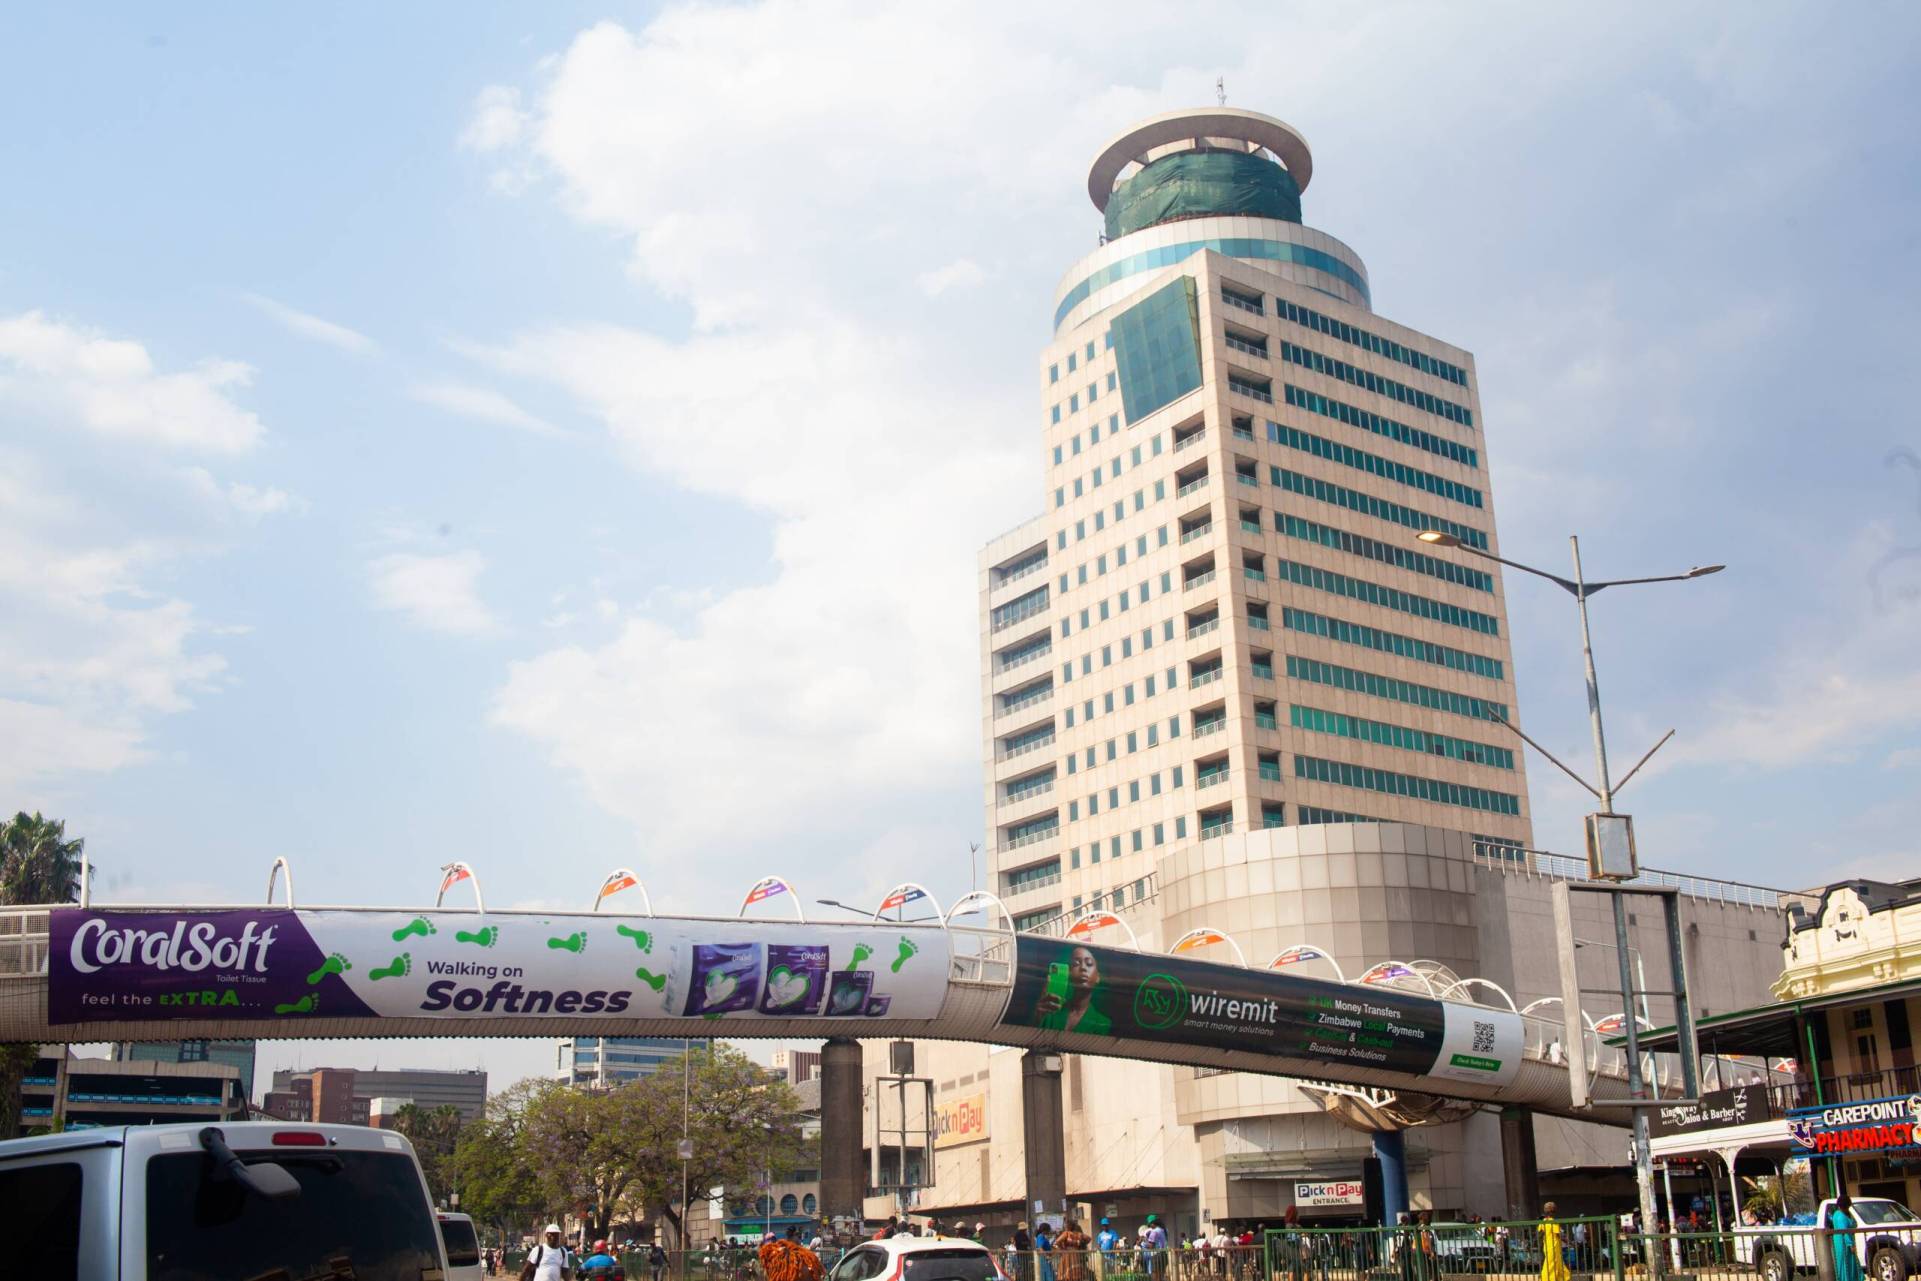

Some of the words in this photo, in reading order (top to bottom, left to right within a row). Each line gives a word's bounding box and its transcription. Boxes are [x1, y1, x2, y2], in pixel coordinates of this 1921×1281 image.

[70, 918, 277, 973] CoralSoft
[216, 974, 239, 983] Toilet
[242, 974, 267, 984] Tissue
[427, 961, 498, 979] Walking
[502, 965, 523, 978] on
[81, 993, 115, 1006] feel
[122, 993, 153, 1006] the
[420, 980, 632, 1014] Softness
[1191, 990, 1279, 1024] wiremit
[1334, 1000, 1362, 1015] Money
[1363, 1003, 1401, 1019] Transfers
[1184, 1019, 1209, 1030] smart
[1209, 1022, 1238, 1034] money
[1239, 1024, 1275, 1037] solutions
[1318, 1012, 1362, 1029] Zimbabwe
[1386, 1022, 1425, 1039] Payments
[1348, 1032, 1356, 1043] &
[1308, 1042, 1348, 1057] Business
[1348, 1047, 1387, 1062] Solutions
[959, 1103, 982, 1134] Pay
[1702, 1111, 1709, 1121] &
[1709, 1107, 1735, 1120] Barber
[1823, 1100, 1906, 1125] CAREPOINT
[1815, 1122, 1914, 1153] PHARMACY
[1298, 1185, 1325, 1198] Pick
[1326, 1187, 1334, 1195] n
[1336, 1183, 1363, 1197] Pay
